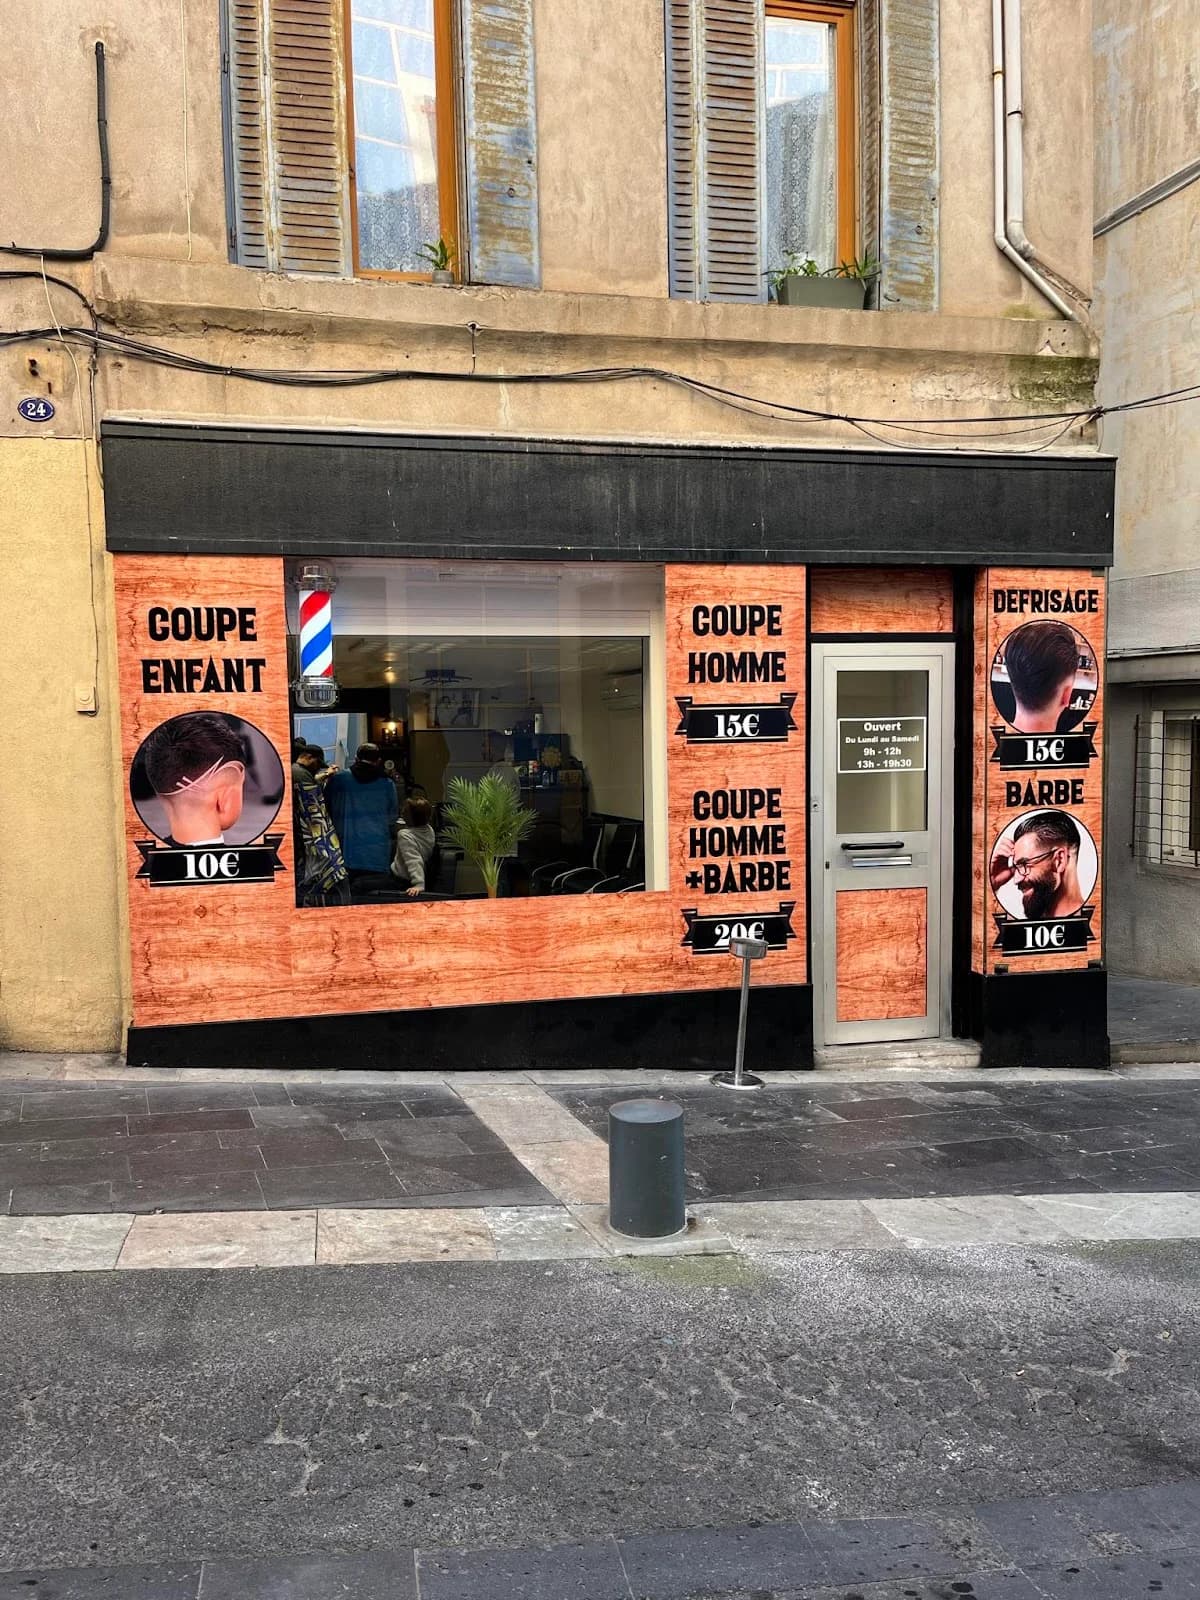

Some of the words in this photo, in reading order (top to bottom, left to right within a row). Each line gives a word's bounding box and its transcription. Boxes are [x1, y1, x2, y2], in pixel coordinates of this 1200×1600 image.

[27, 402, 46, 416] 24
[993, 587, 1099, 613] DEFRISAGE
[148, 606, 257, 642] COUPE
[692, 604, 783, 637] COUPE
[141, 655, 266, 694] ENFANT
[688, 651, 787, 684] HOMME
[714, 713, 760, 738] 15€
[863, 721, 902, 732] Ouvert
[845, 736, 856, 744] Du
[857, 735, 879, 743] Lundi
[891, 735, 920, 743] Samedi
[863, 747, 876, 756] 9h
[884, 746, 902, 755] 12h
[1024, 739, 1065, 762] 15€
[857, 760, 875, 768] 13h
[883, 759, 912, 767] 19h30
[693, 787, 782, 820] COUPE
[1005, 778, 1085, 808] BARBE
[689, 825, 786, 859] HOMME
[183, 852, 240, 879] 10€
[1023, 925, 1065, 949] 10€
